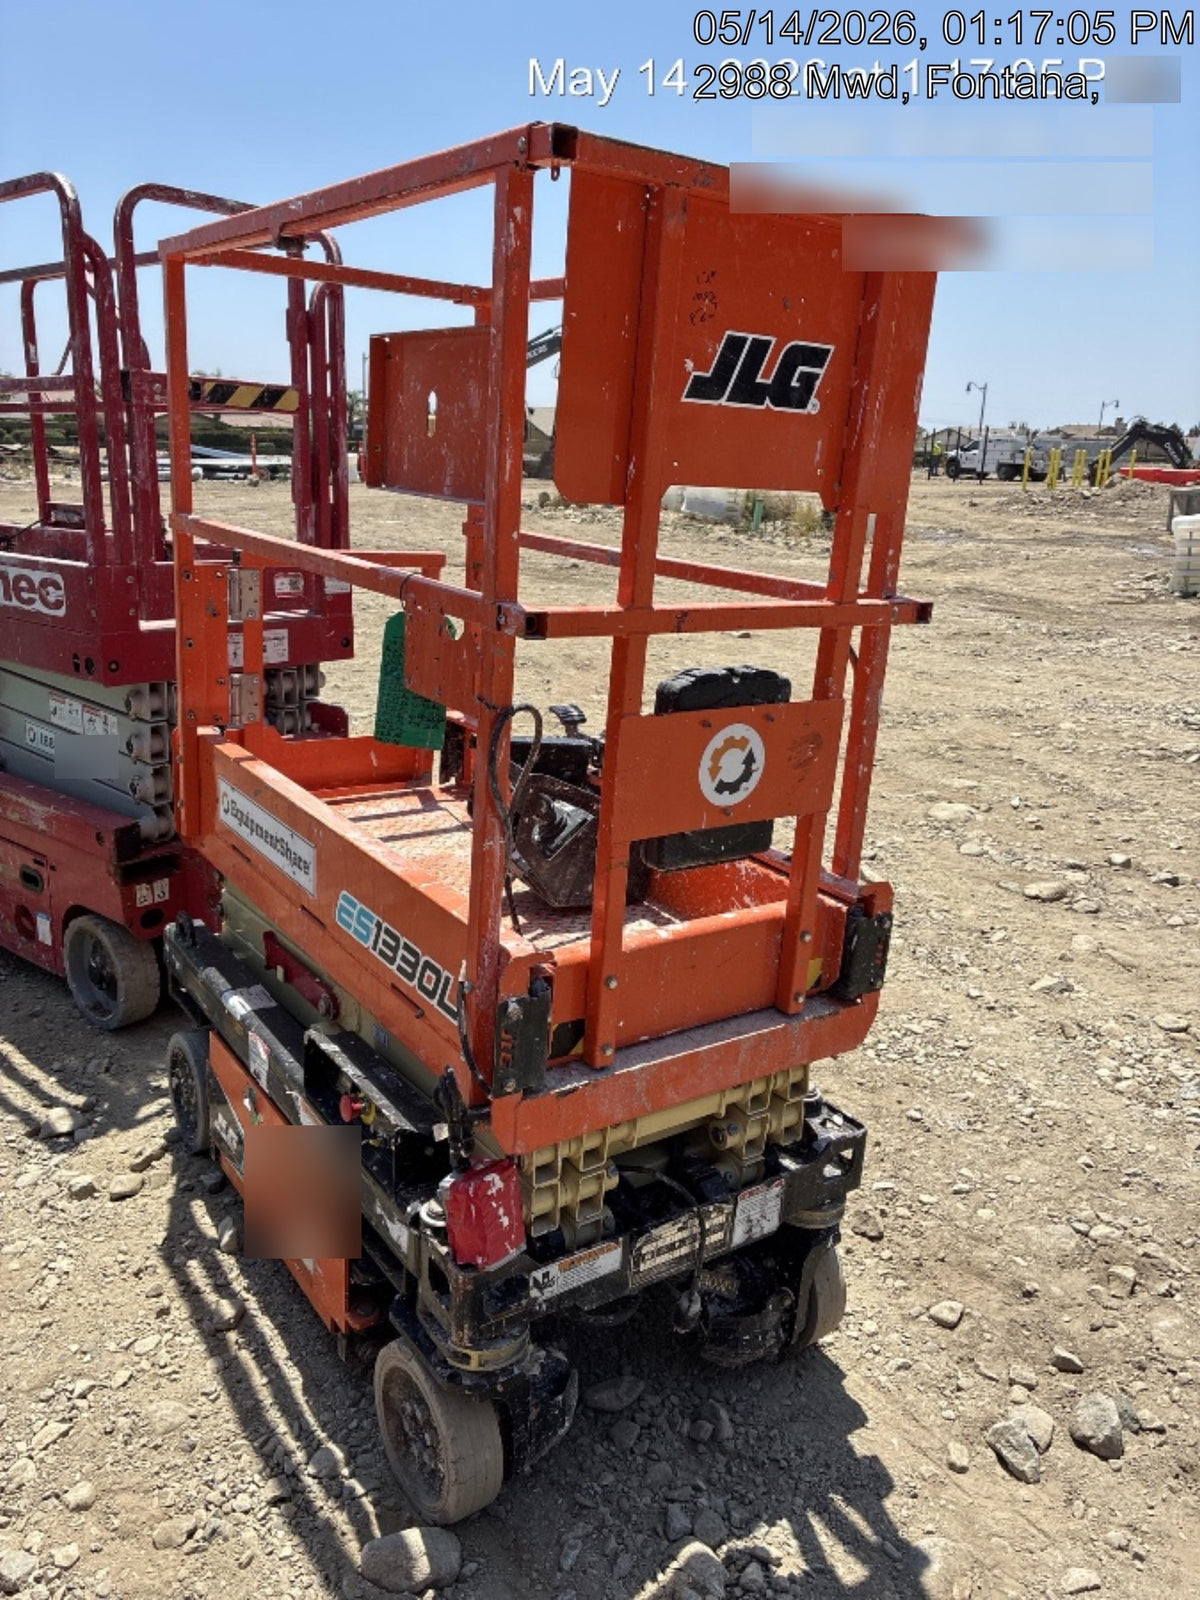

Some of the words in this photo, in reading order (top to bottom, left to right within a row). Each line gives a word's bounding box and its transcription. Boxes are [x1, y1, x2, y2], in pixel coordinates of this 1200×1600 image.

[681, 330, 836, 414] JLG
[229, 797, 311, 877] EquipmentShare
[336, 890, 459, 1026] ES1330L
